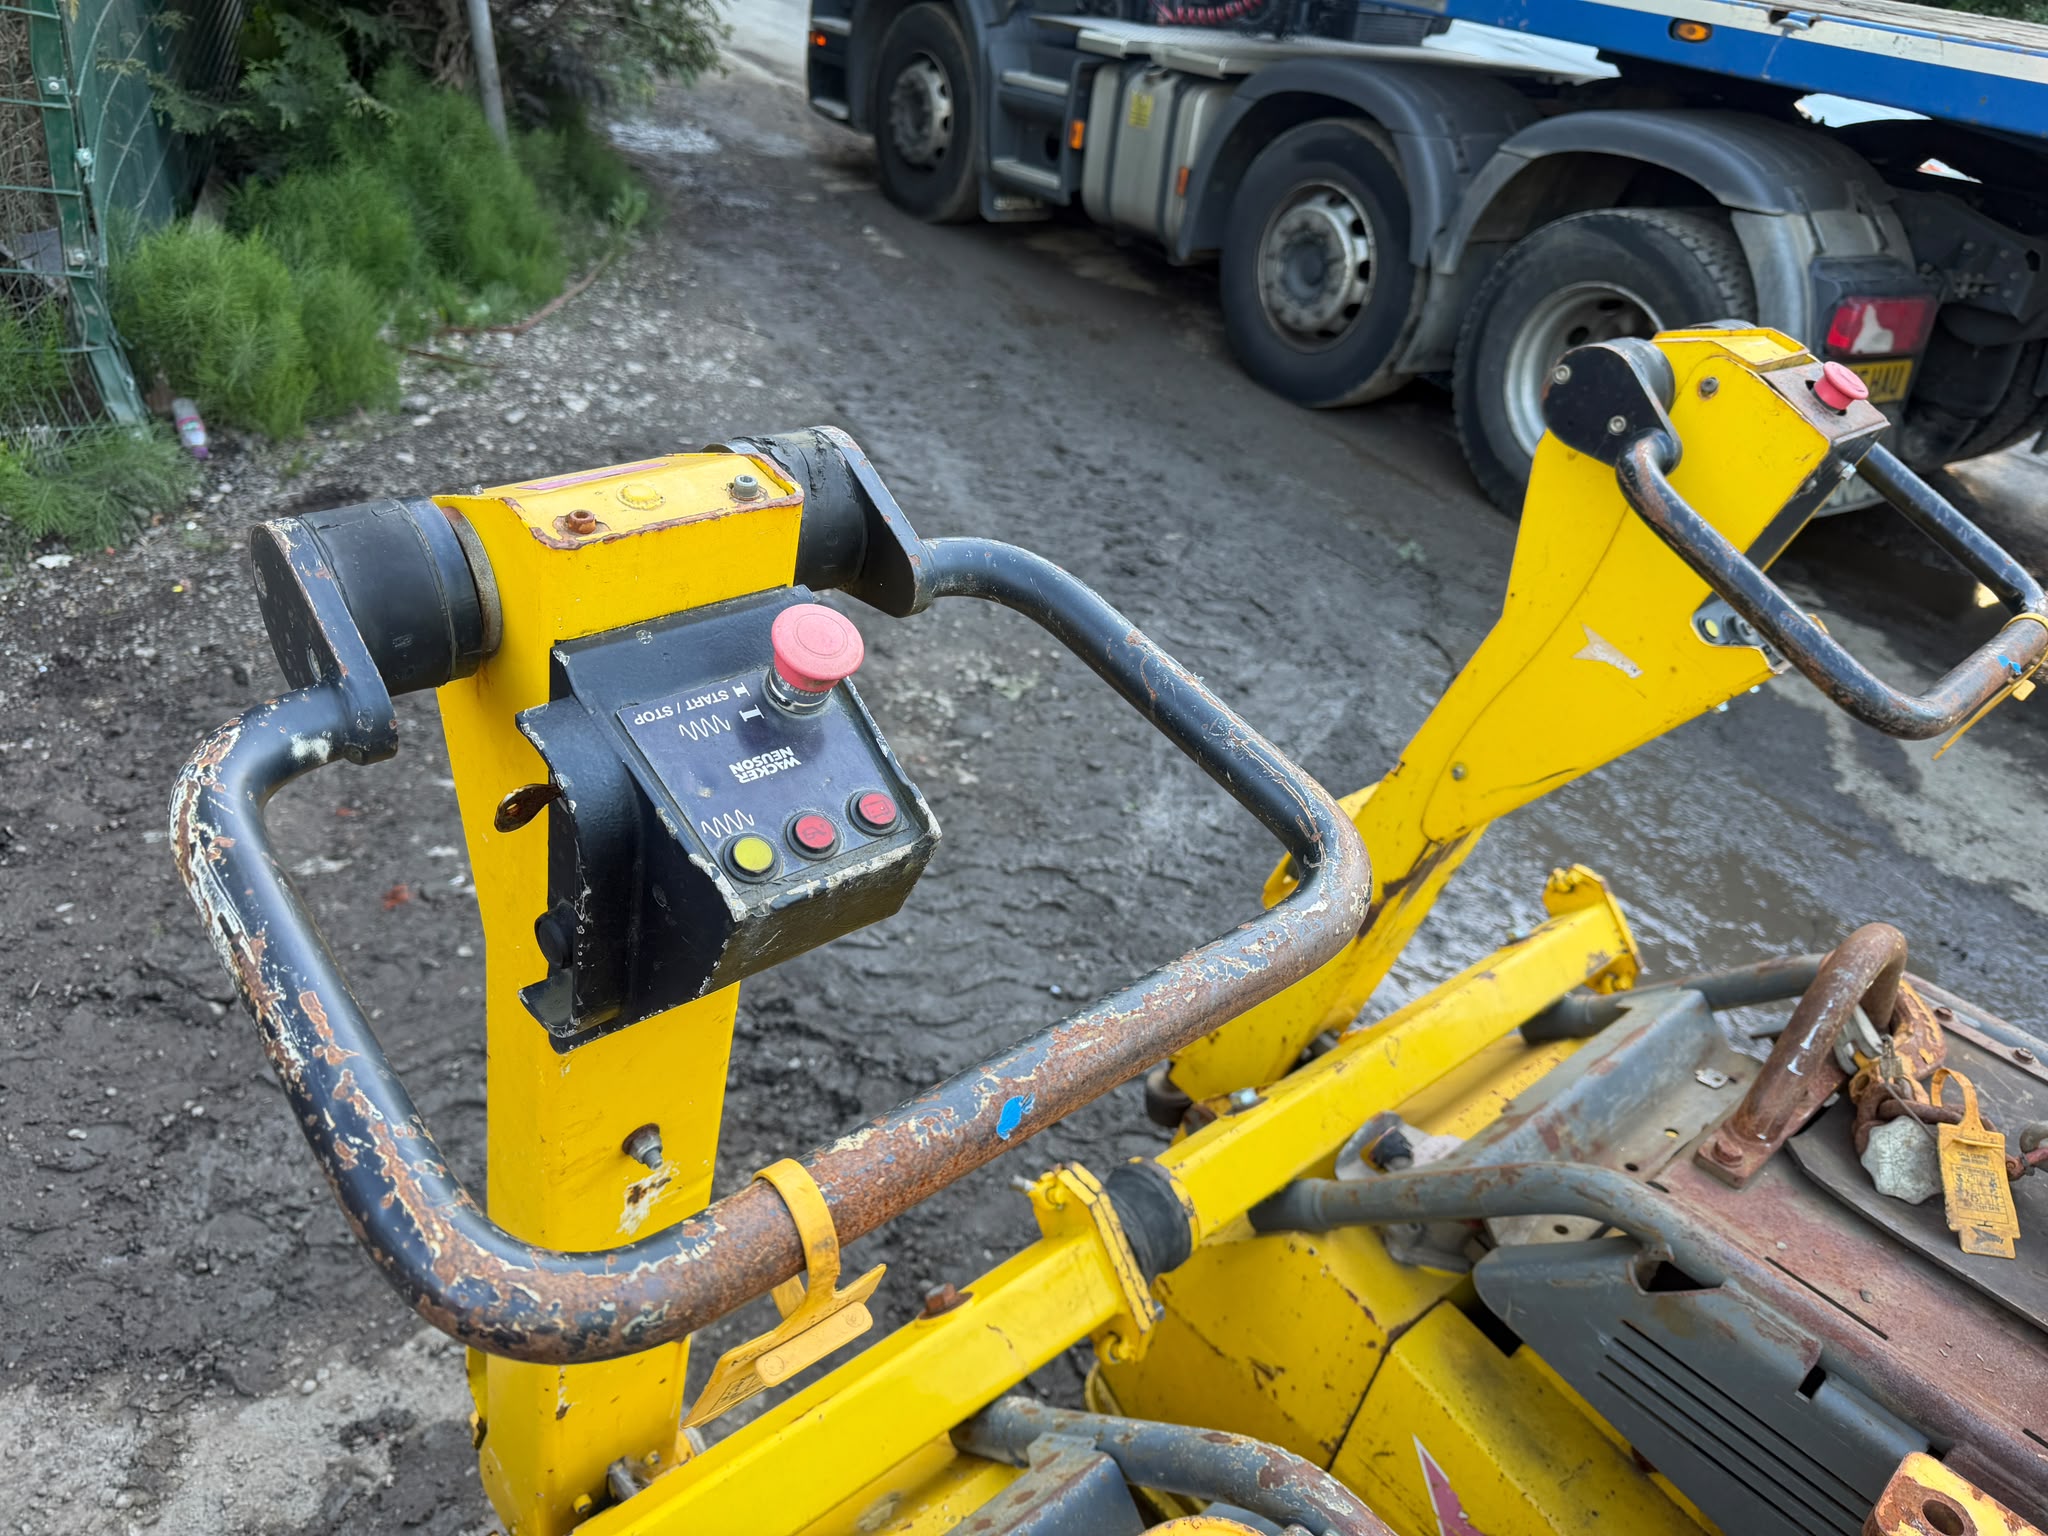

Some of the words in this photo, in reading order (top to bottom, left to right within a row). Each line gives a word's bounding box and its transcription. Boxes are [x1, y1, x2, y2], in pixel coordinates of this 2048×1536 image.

[676, 702, 682, 714] /
[686, 690, 730, 711] START
[634, 705, 674, 725] STOP
[729, 746, 795, 775] NEUSON
[736, 757, 802, 784] WACKER
